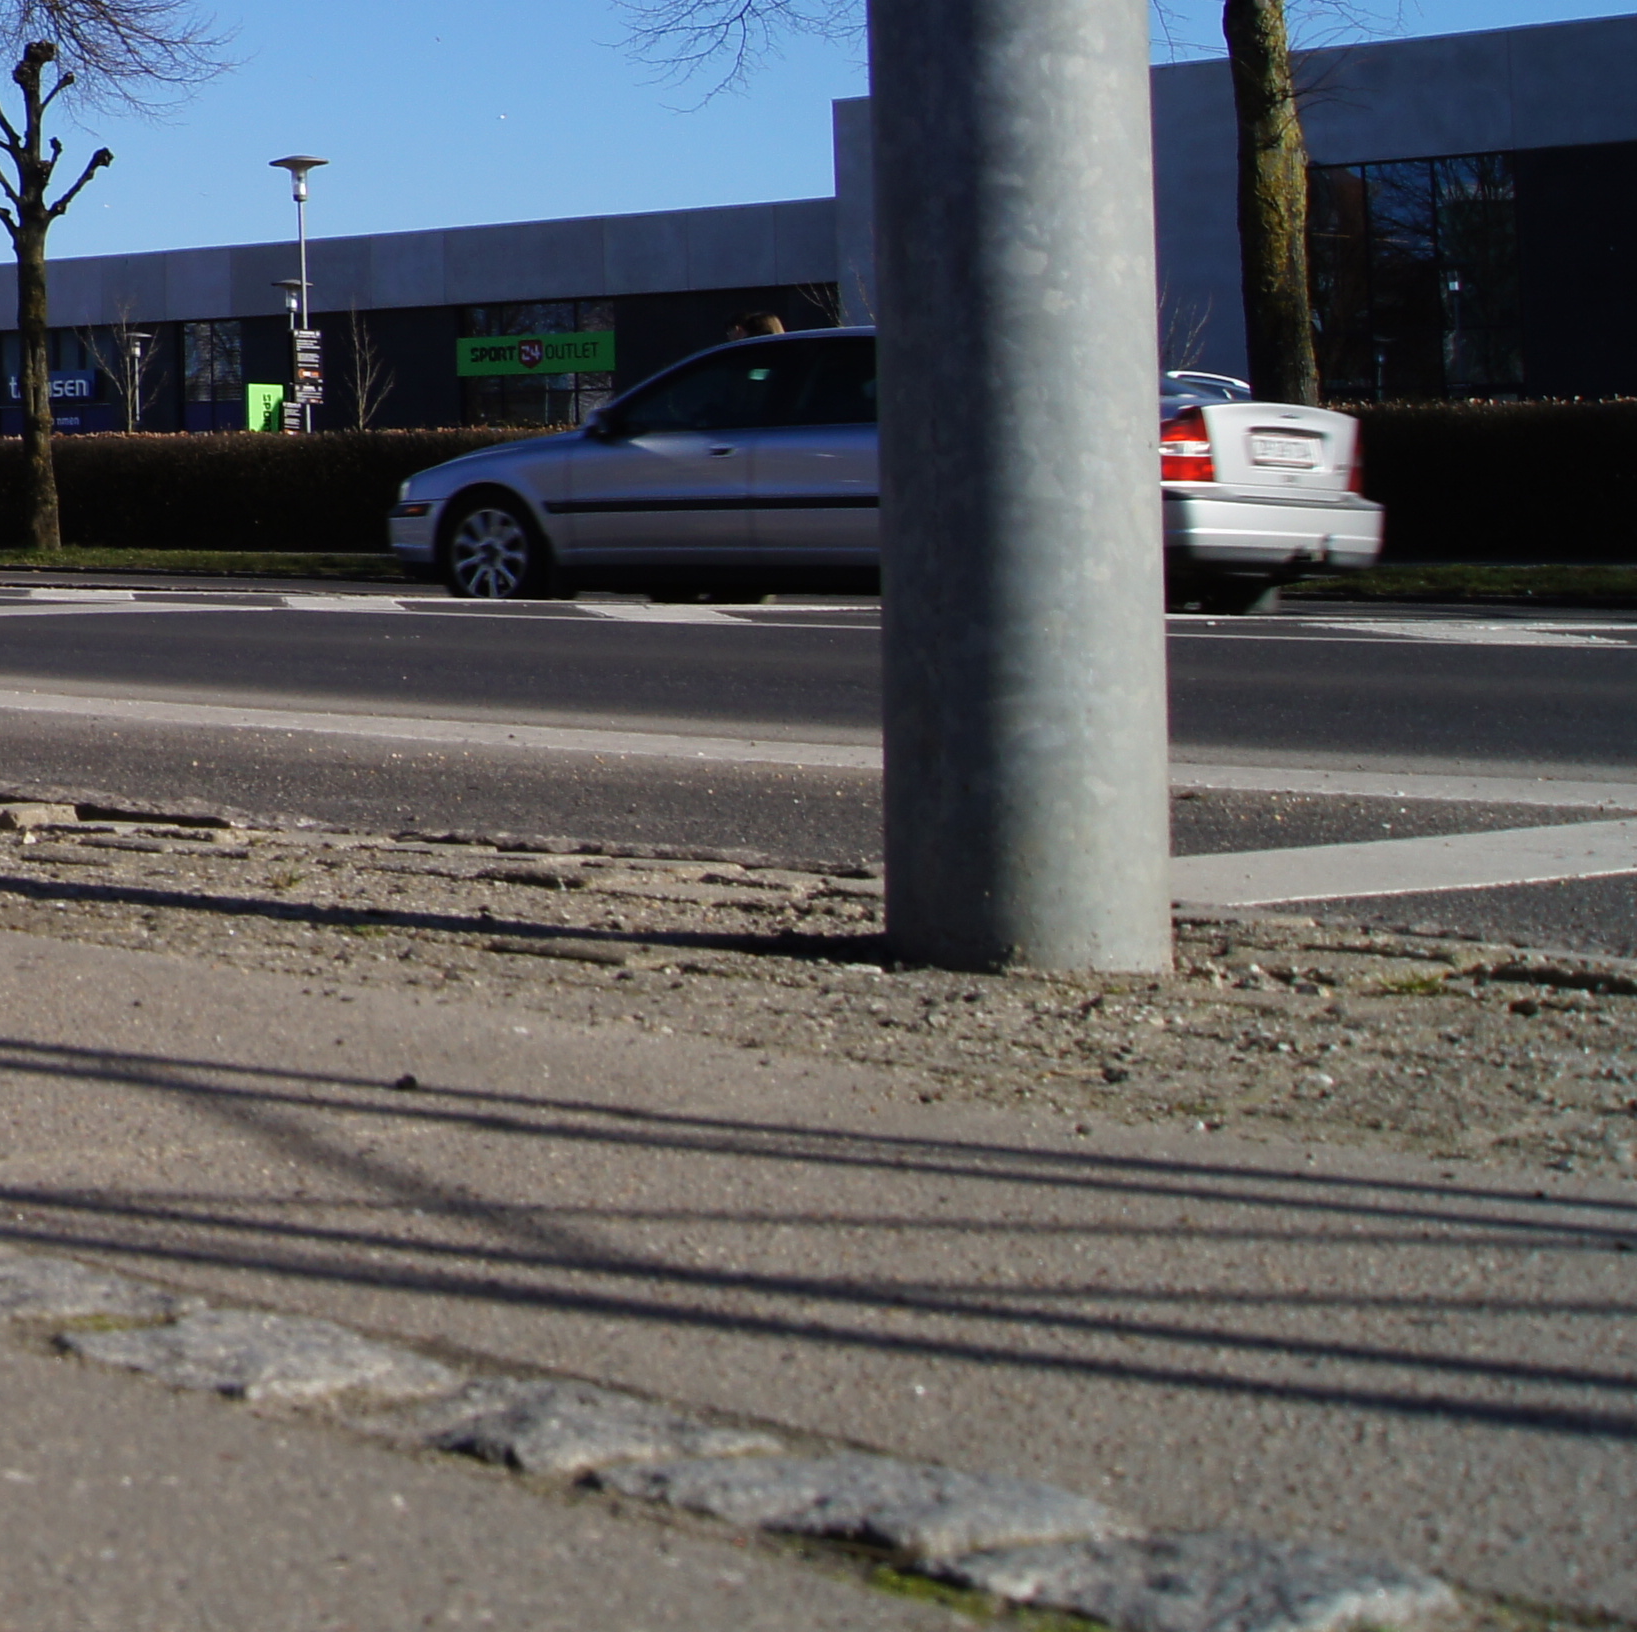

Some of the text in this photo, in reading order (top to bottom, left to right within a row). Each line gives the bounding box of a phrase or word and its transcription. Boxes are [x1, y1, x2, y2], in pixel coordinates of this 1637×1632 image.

[470, 342, 599, 363] SPORT 24 OUTLET
